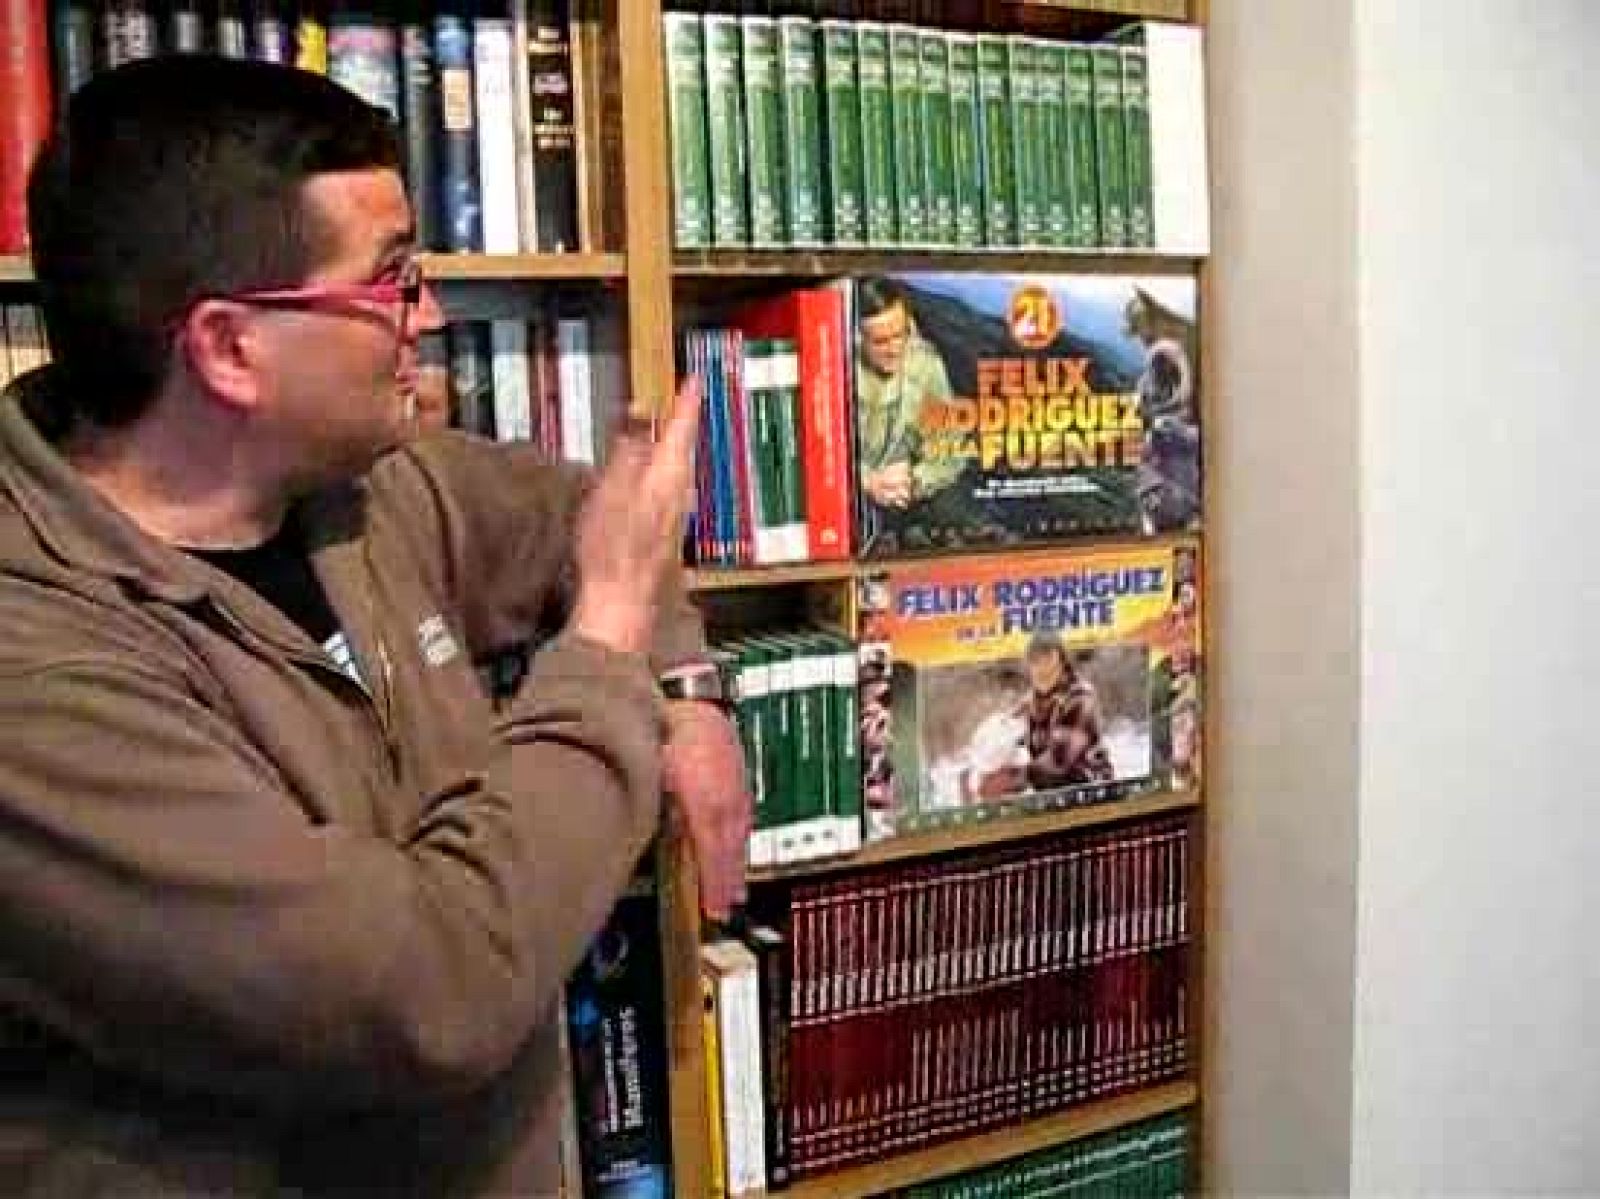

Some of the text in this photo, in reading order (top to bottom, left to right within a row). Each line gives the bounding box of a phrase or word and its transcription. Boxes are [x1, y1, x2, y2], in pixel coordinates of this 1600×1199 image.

[977, 358, 1092, 396] FELIX
[979, 429, 1143, 470] FUENTE
[899, 584, 981, 616] FELIX
[1004, 602, 1115, 635] FUENTE
